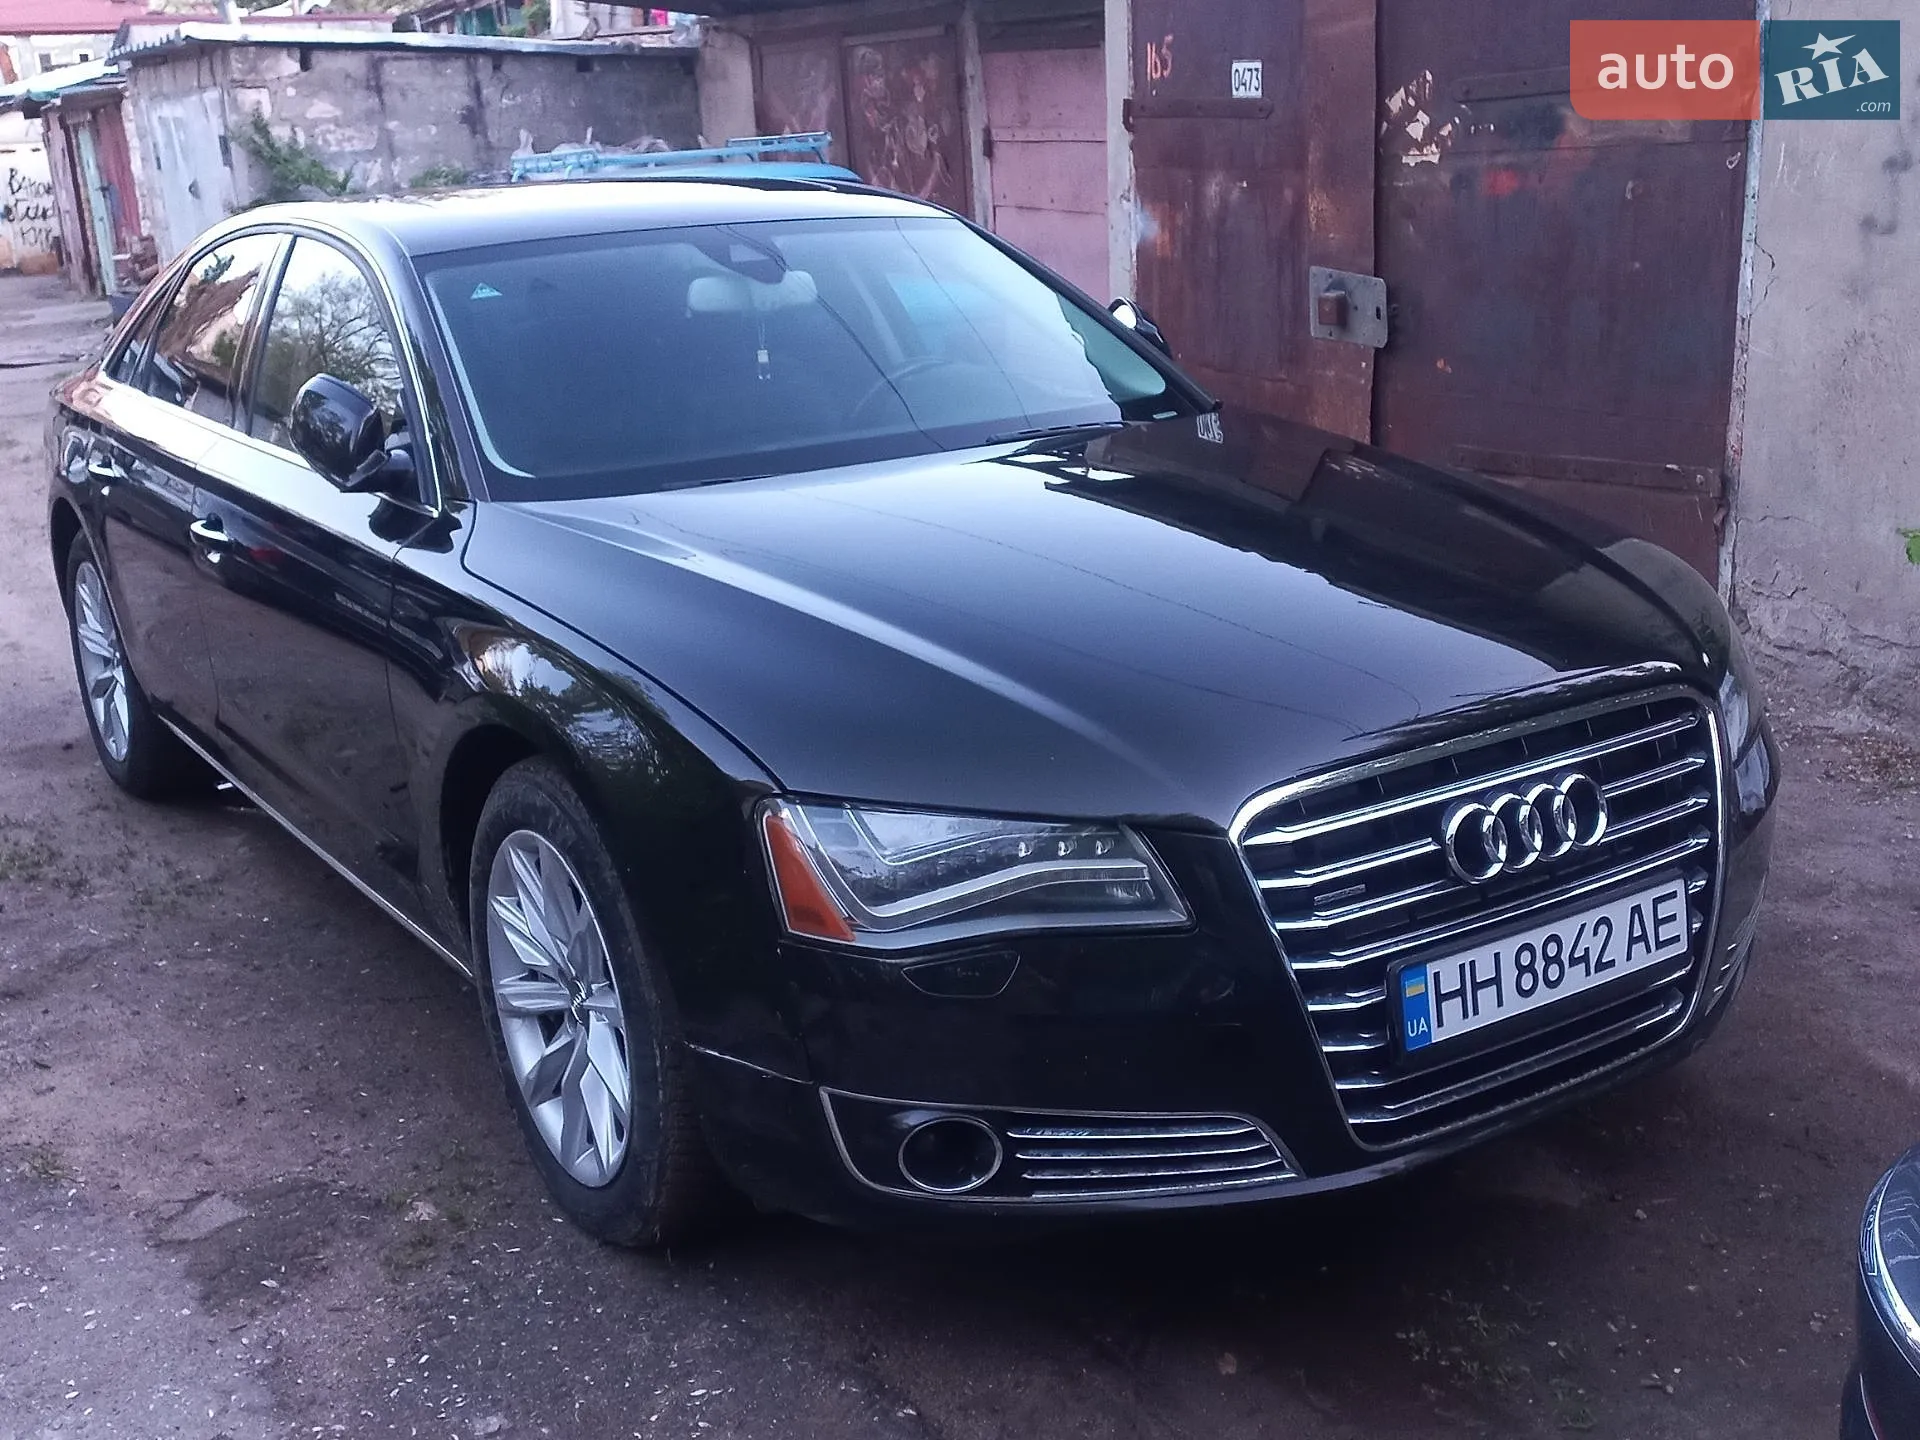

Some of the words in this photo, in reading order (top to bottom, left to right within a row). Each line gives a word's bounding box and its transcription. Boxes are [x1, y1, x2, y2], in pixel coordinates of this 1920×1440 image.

[1147, 34, 1174, 82] 165
[1233, 66, 1261, 92] 0473
[1433, 951, 1504, 1029] HH
[1514, 915, 1616, 999] 8842
[1626, 889, 1681, 963] AE
[1407, 1016, 1429, 1038] UA
